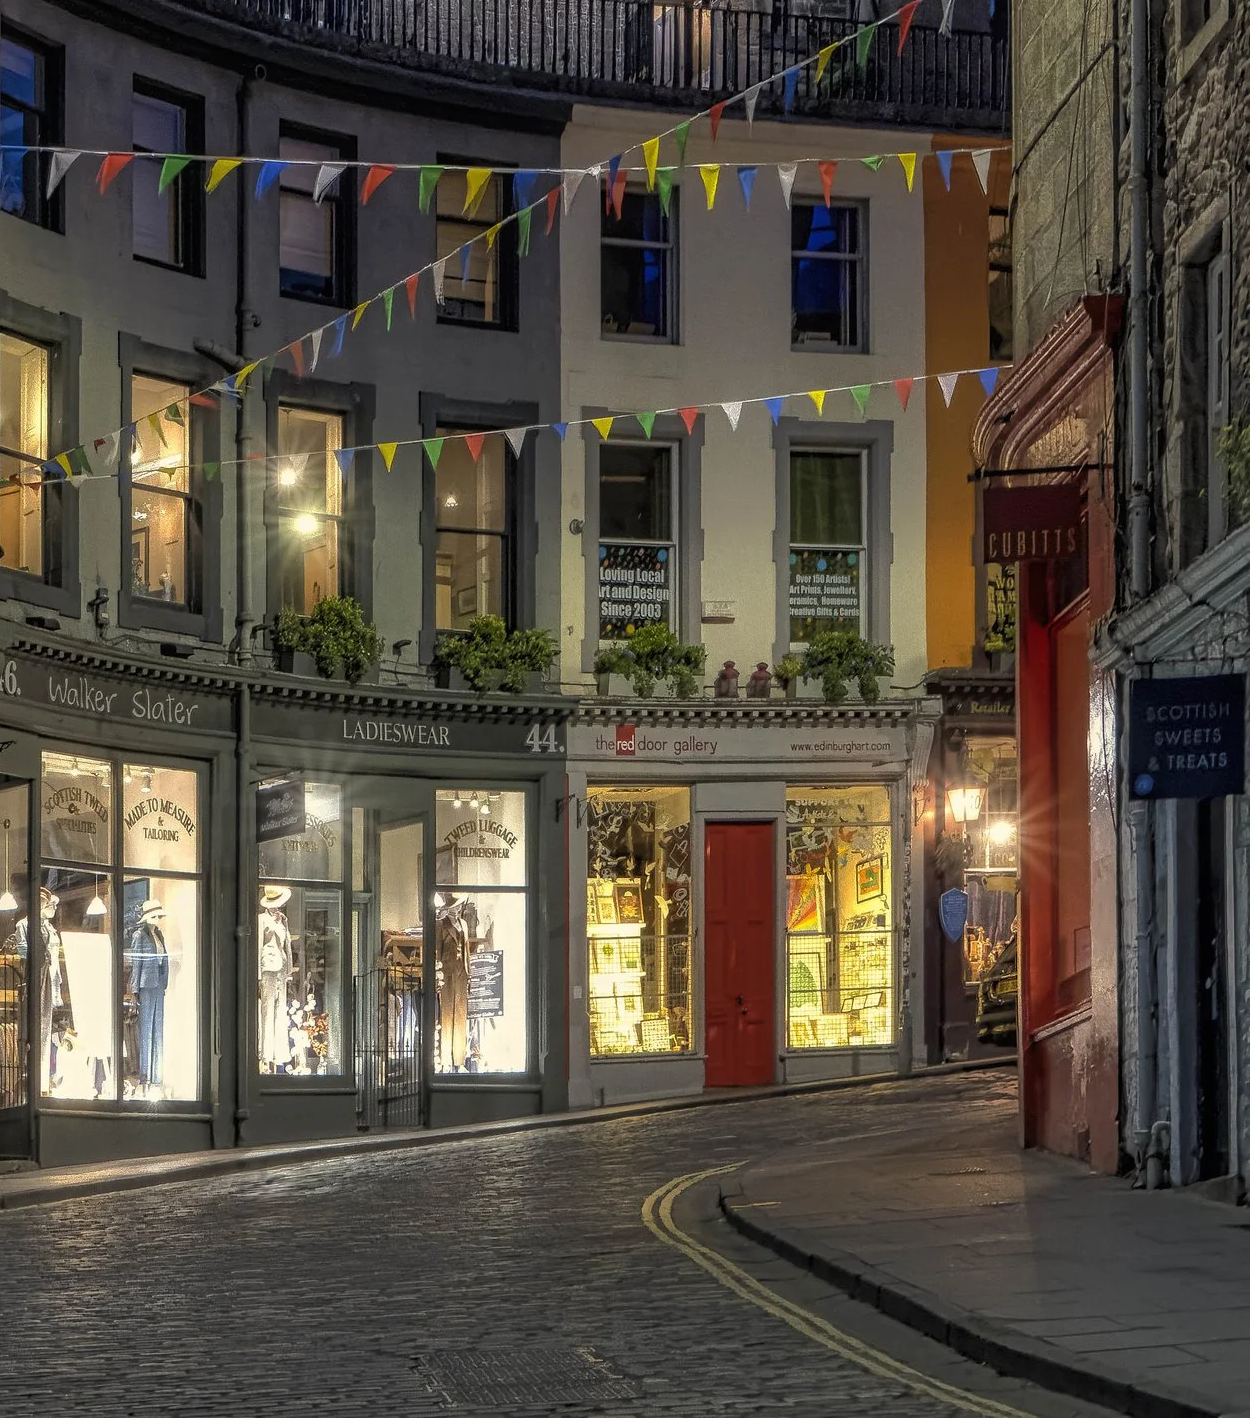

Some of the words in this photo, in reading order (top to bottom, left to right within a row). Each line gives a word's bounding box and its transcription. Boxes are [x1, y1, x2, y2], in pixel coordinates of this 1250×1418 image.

[989, 527, 1076, 558] CUBITTS
[600, 566, 635, 584] Loving
[636, 568, 665, 583] Local
[795, 574, 811, 584] Over
[813, 574, 825, 584] 150
[611, 586, 632, 599] and
[633, 585, 670, 602] Design
[790, 596, 819, 606] eramics,
[601, 601, 632, 617] Since
[633, 603, 661, 618] 2003
[49, 676, 118, 713] Walker
[132, 689, 198, 725] Slater
[1146, 703, 1230, 722] SCOTTISH
[342, 719, 450, 746] LADIESWEAR
[525, 724, 565, 753] 44.
[1154, 727, 1222, 745] SWEETS
[595, 734, 615, 751] the
[616, 735, 635, 751] red
[637, 735, 667, 752] door
[673, 735, 717, 755] gallery
[790, 740, 891, 754] www.edinburghart.com
[1168, 752, 1227, 770] TREATS
[84, 790, 109, 823] TWEED
[124, 801, 148, 832] MADE
[147, 798, 159, 813] TO
[160, 798, 196, 836] MEASURE
[157, 816, 164, 826] &
[143, 827, 180, 842] TAILORING
[444, 820, 477, 846] TWEED
[478, 819, 518, 849] LUGGAGE
